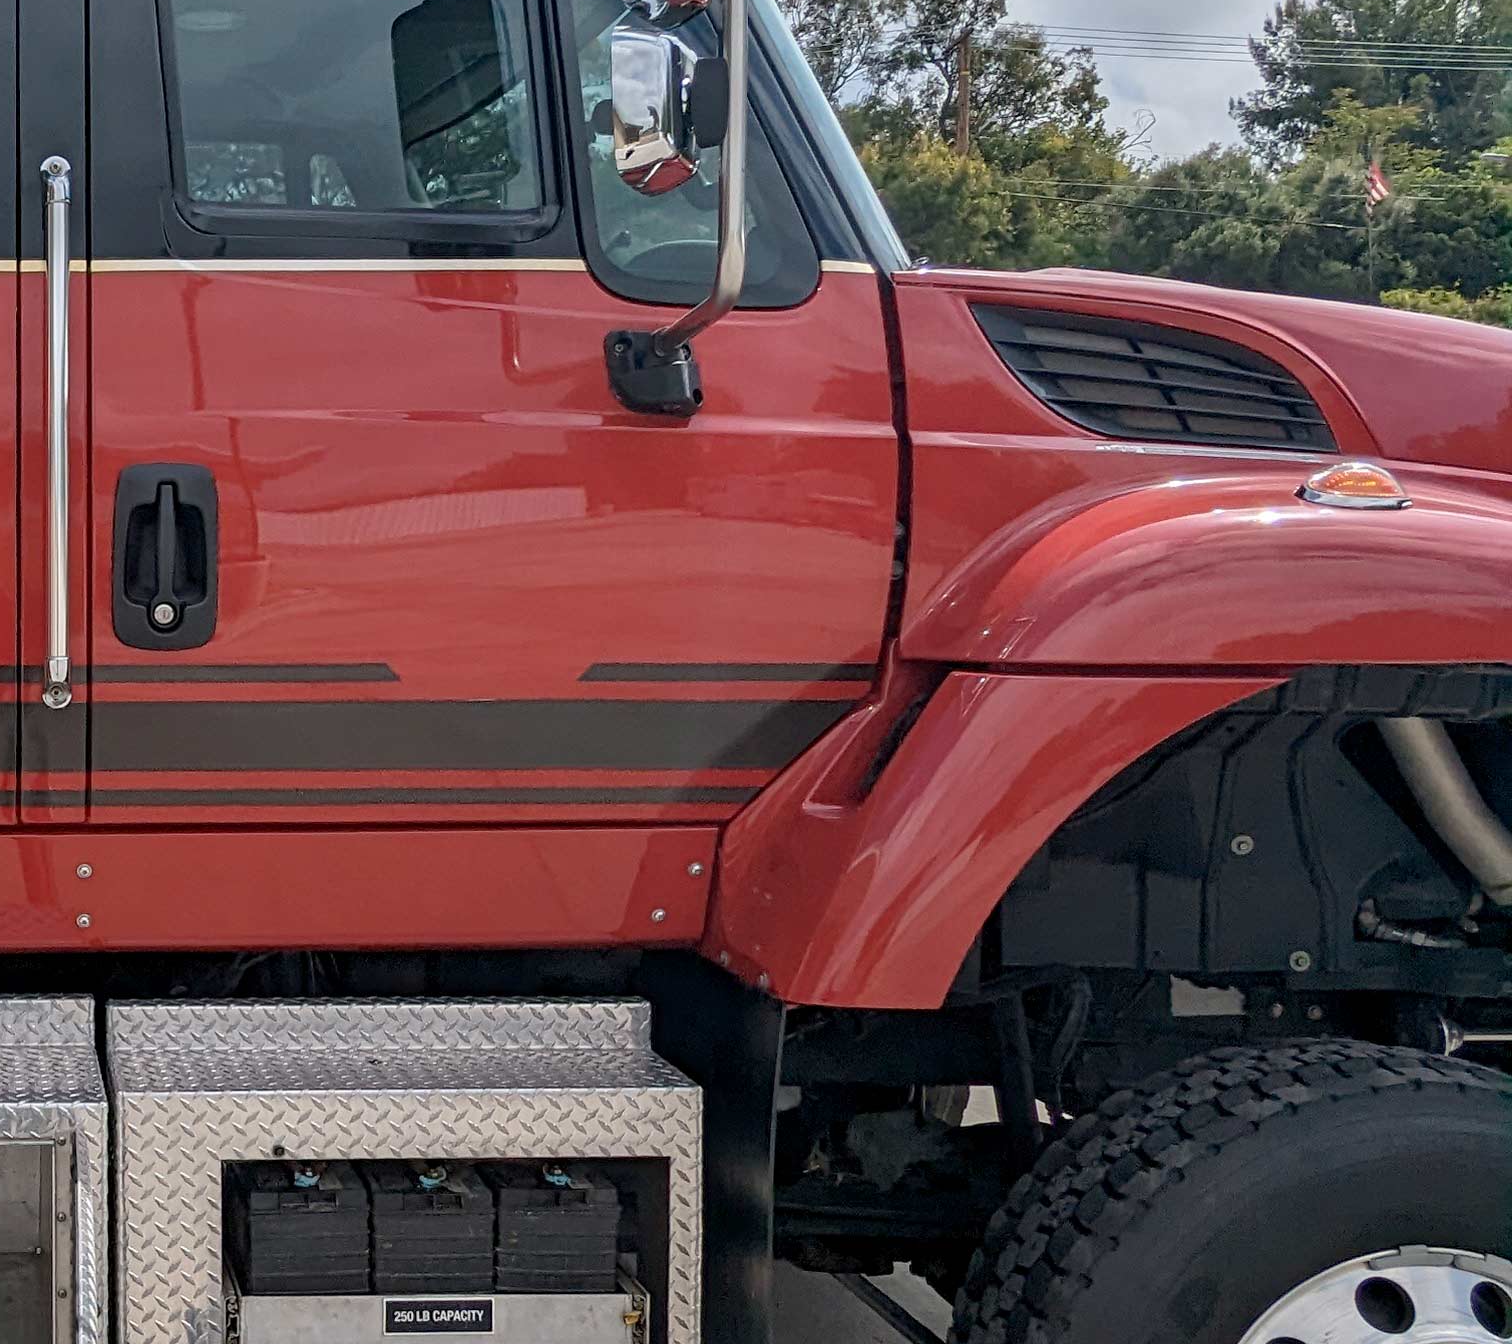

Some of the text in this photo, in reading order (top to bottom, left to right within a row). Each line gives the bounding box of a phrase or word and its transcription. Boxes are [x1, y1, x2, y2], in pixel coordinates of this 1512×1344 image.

[393, 1309, 484, 1323] 250 LB CAPACITY
